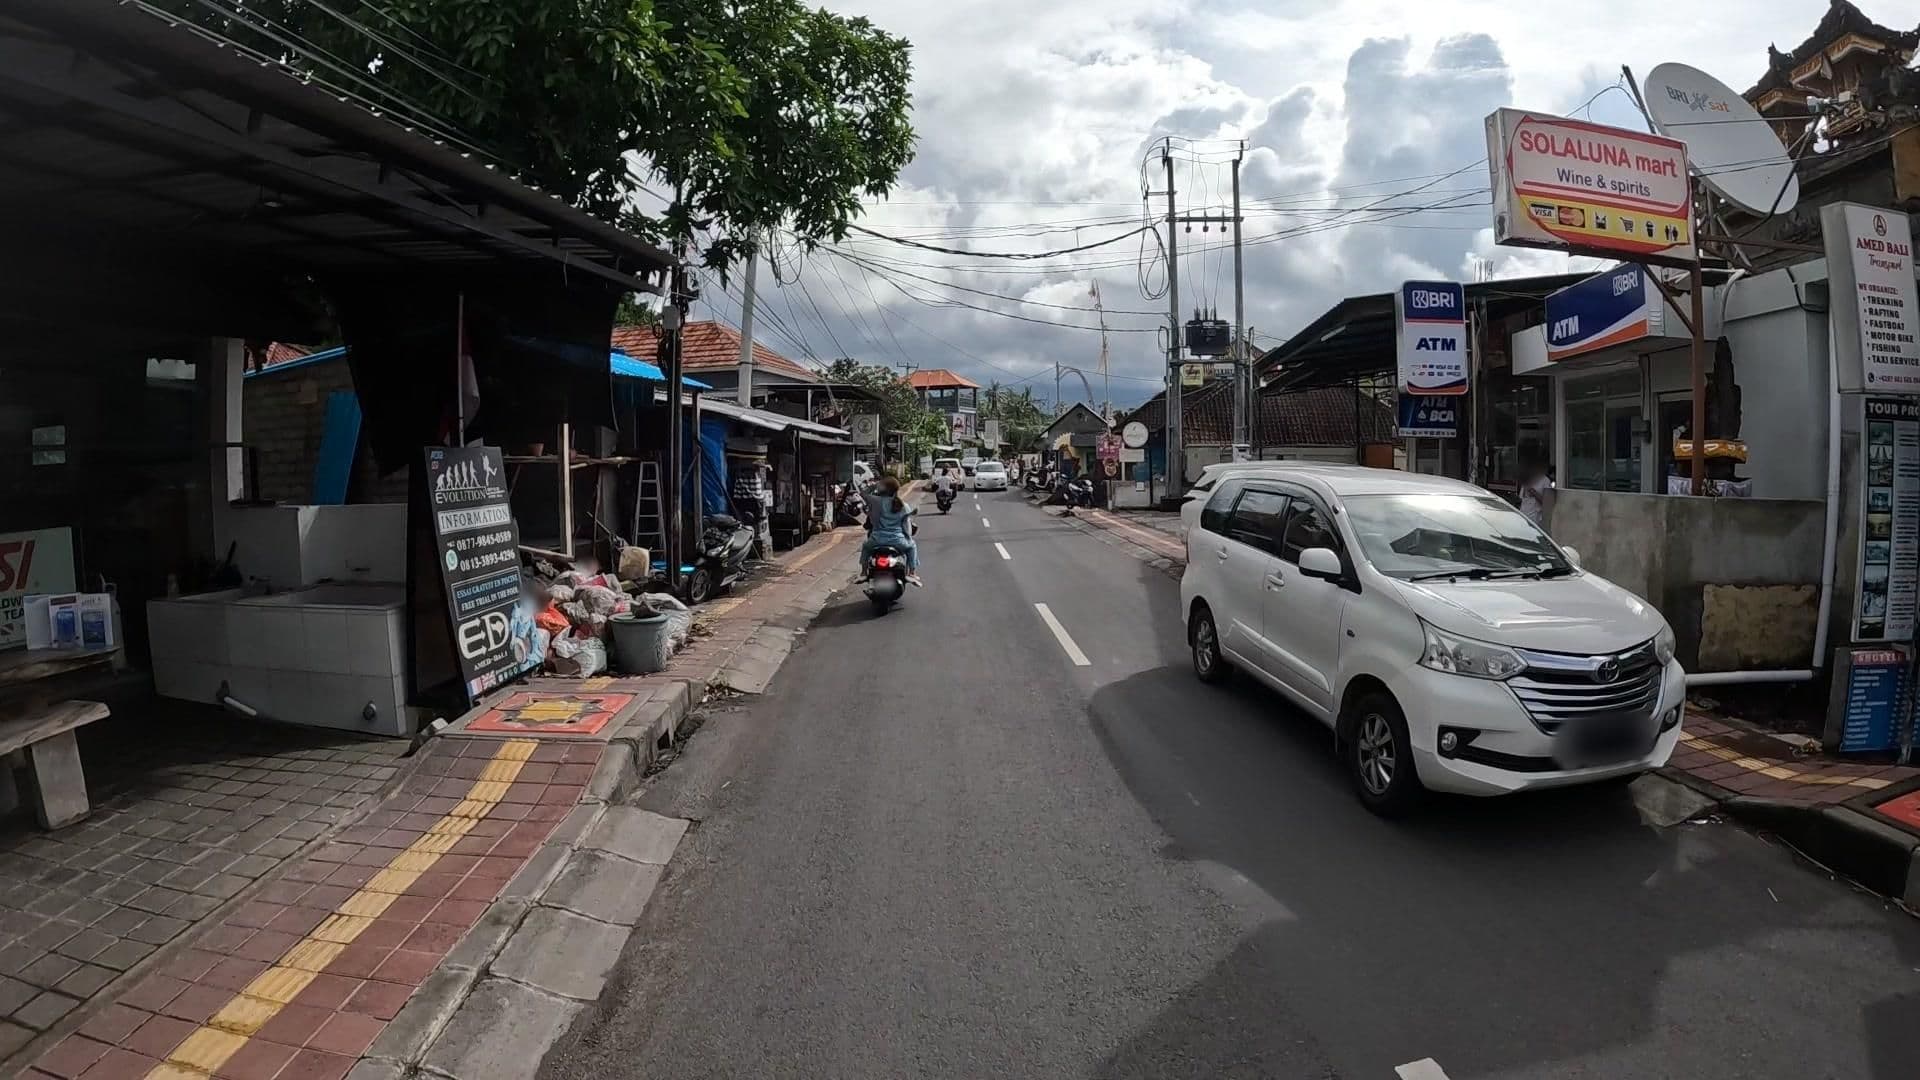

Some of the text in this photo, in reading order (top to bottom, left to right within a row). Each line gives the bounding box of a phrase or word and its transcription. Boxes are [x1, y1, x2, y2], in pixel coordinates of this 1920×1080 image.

[1665, 86, 1729, 112] BRI sat
[1519, 130, 1678, 177] SOLALUNA mart
[1556, 168, 1651, 196] Wine & spirits
[1534, 208, 1552, 217] VISA
[1856, 236, 1909, 256] AMED BALI
[1623, 270, 1639, 291] BRI
[1429, 292, 1454, 308] BRI
[1867, 296, 1903, 307] TREKKING
[1868, 308, 1899, 318] RAFTING
[1552, 315, 1579, 341] ATM
[1870, 320, 1904, 330] FASTBOAT
[1870, 331, 1914, 343] MOTOR BIKE
[1415, 337, 1456, 351] ATM
[1872, 343, 1901, 353] FISHING
[1872, 355, 1888, 364] TAXI
[1420, 396, 1447, 407] ATM
[1868, 402, 1898, 415] TOUR
[1430, 410, 1454, 422] BCA
[435, 490, 486, 504] EVOLUTION
[440, 507, 508, 529] INFORMATION
[461, 600, 475, 612] FREE
